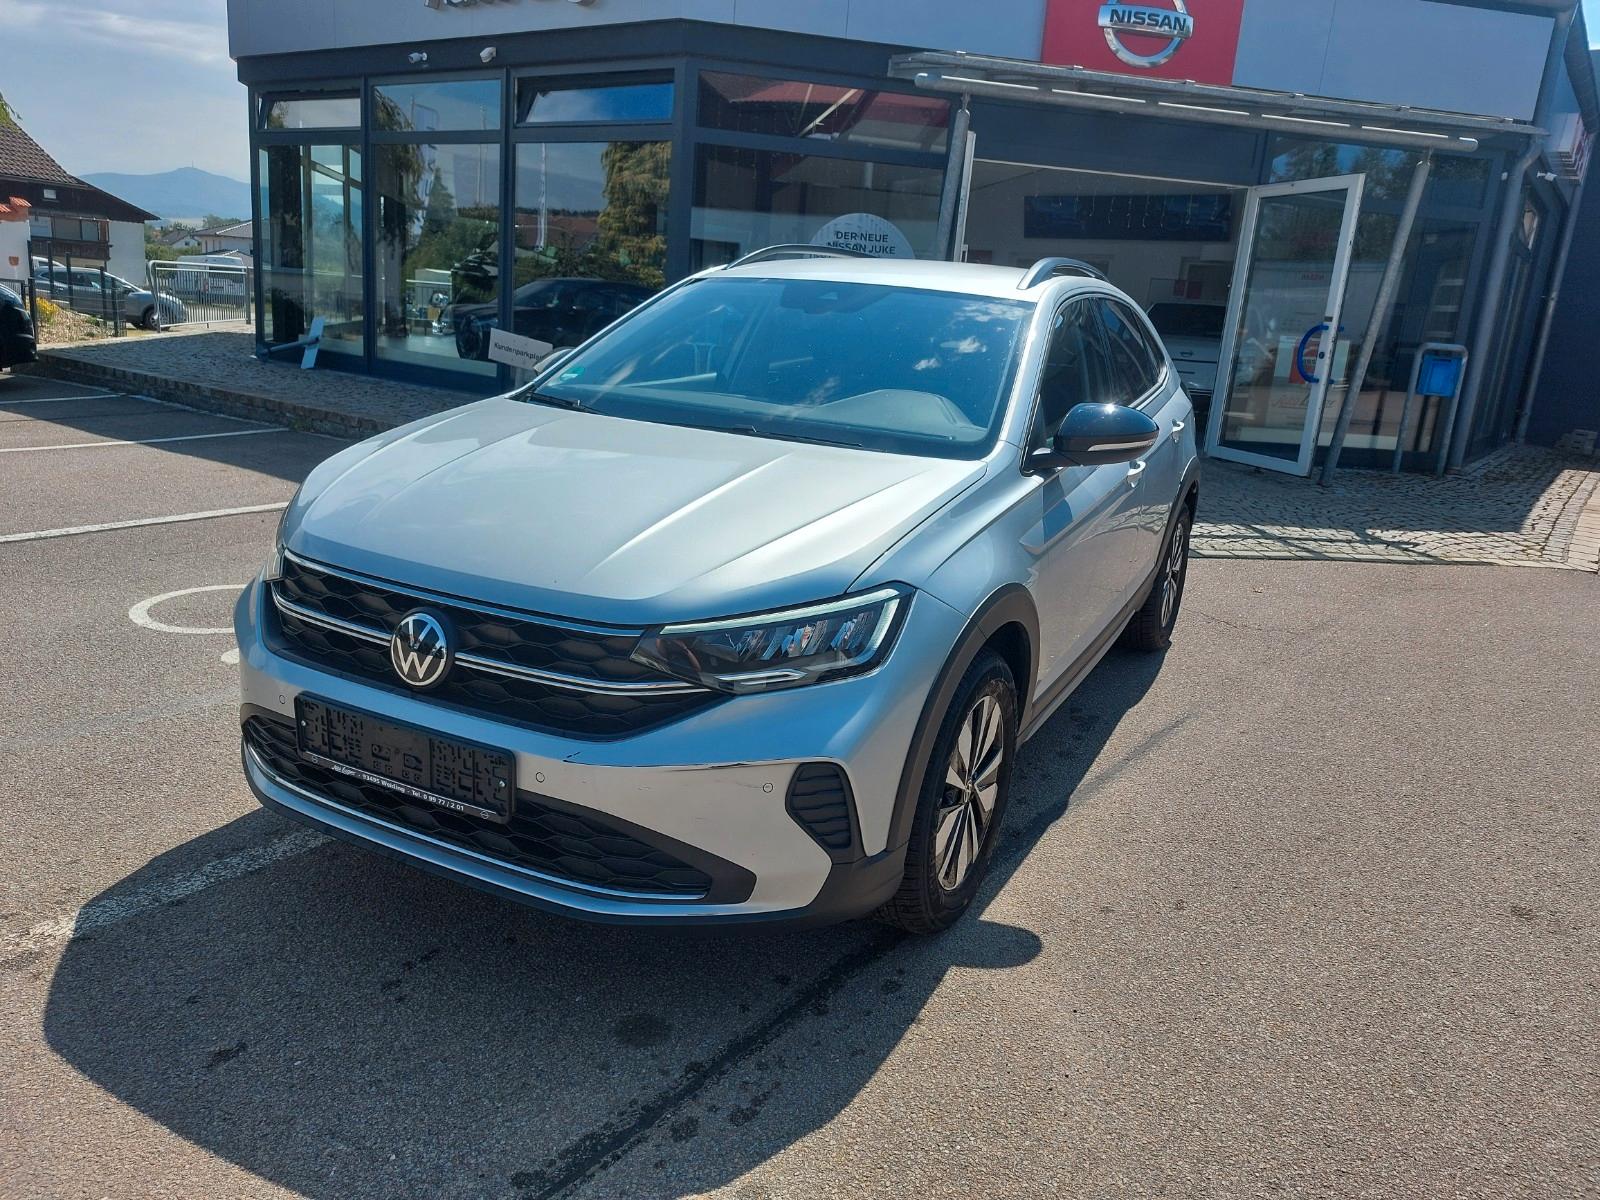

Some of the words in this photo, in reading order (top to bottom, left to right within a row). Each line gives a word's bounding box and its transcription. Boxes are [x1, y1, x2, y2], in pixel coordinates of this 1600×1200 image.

[1109, 9, 1187, 31] NISSAN
[836, 230, 858, 241] DER
[860, 231, 888, 243] NEUE
[868, 244, 896, 255] JUKE
